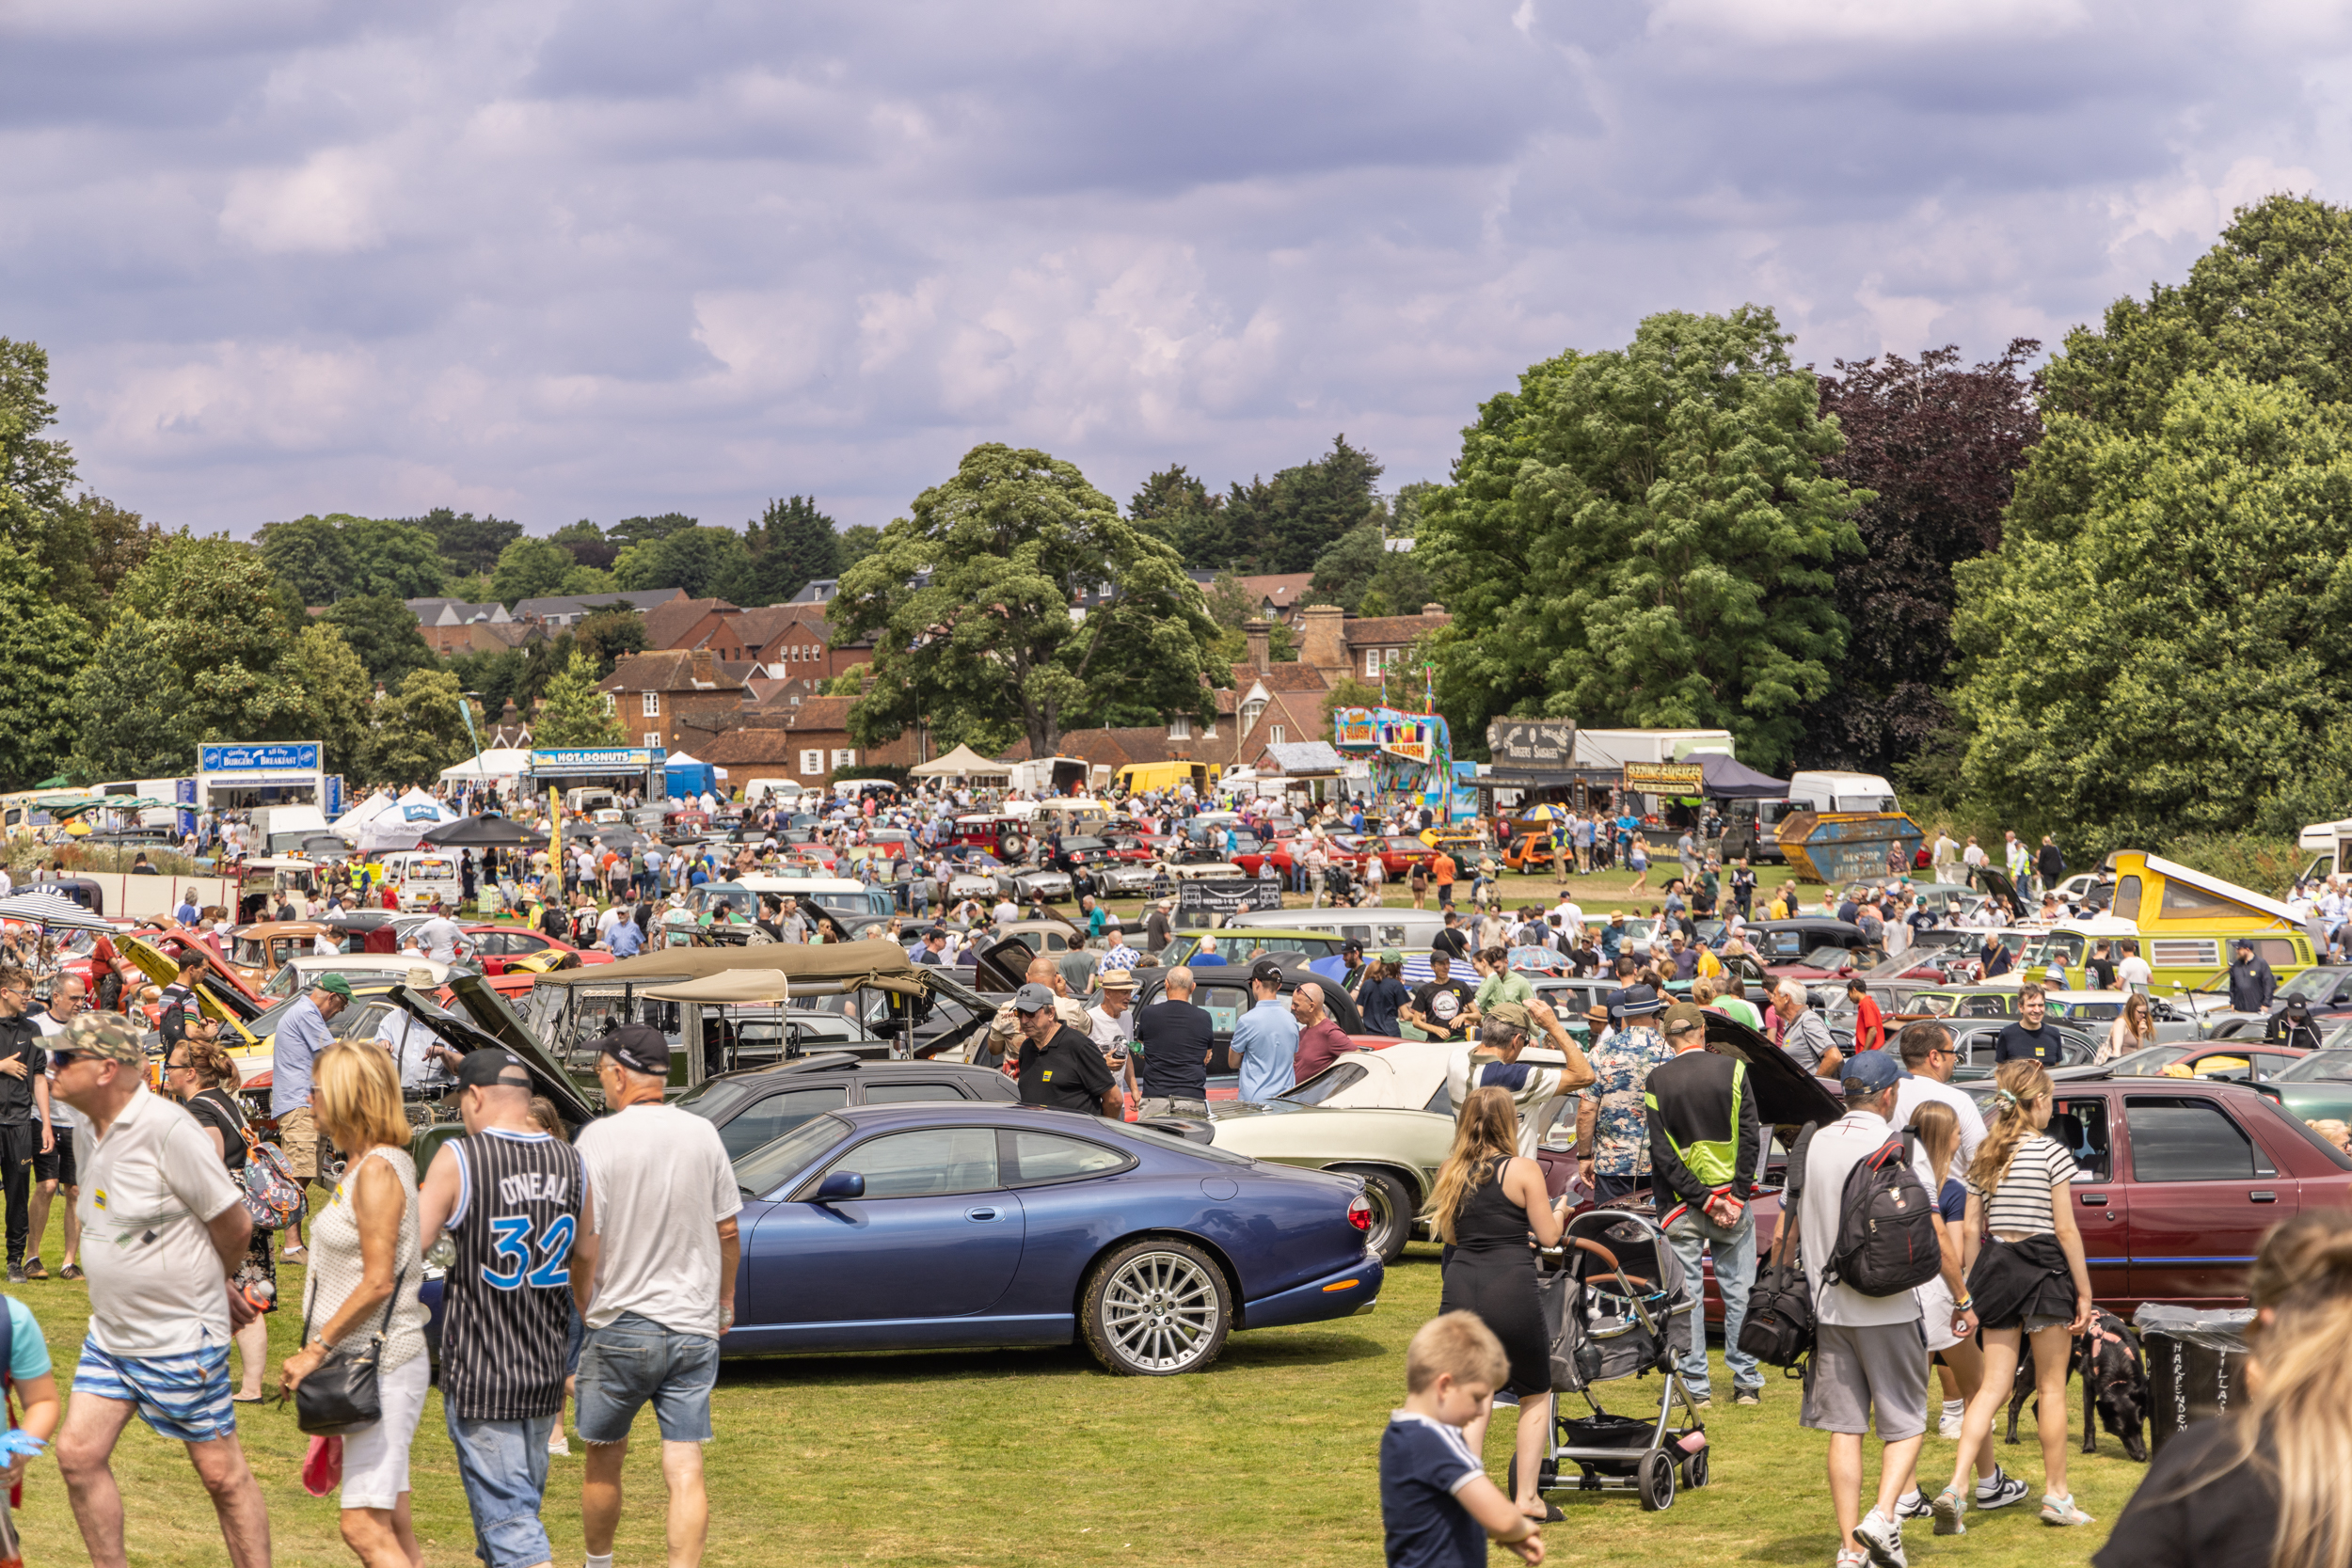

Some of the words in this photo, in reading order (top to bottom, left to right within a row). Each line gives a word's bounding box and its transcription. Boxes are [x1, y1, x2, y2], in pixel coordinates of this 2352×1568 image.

[1346, 724, 1369, 740] SLUSH
[227, 749, 249, 757] Sizzling
[278, 748, 288, 756] Day
[557, 752, 581, 763] HOT
[583, 752, 629, 762] DONUTS
[1391, 744, 1424, 759] SLUSH
[223, 756, 254, 766] BURGERS
[261, 756, 296, 765] BREAKFAST
[500, 1172, 568, 1206] O'NEAL
[1376, 1178, 1390, 1190] T/A
[481, 1213, 577, 1291] 32
[2173, 1341, 2188, 1433] HARPENDEN
